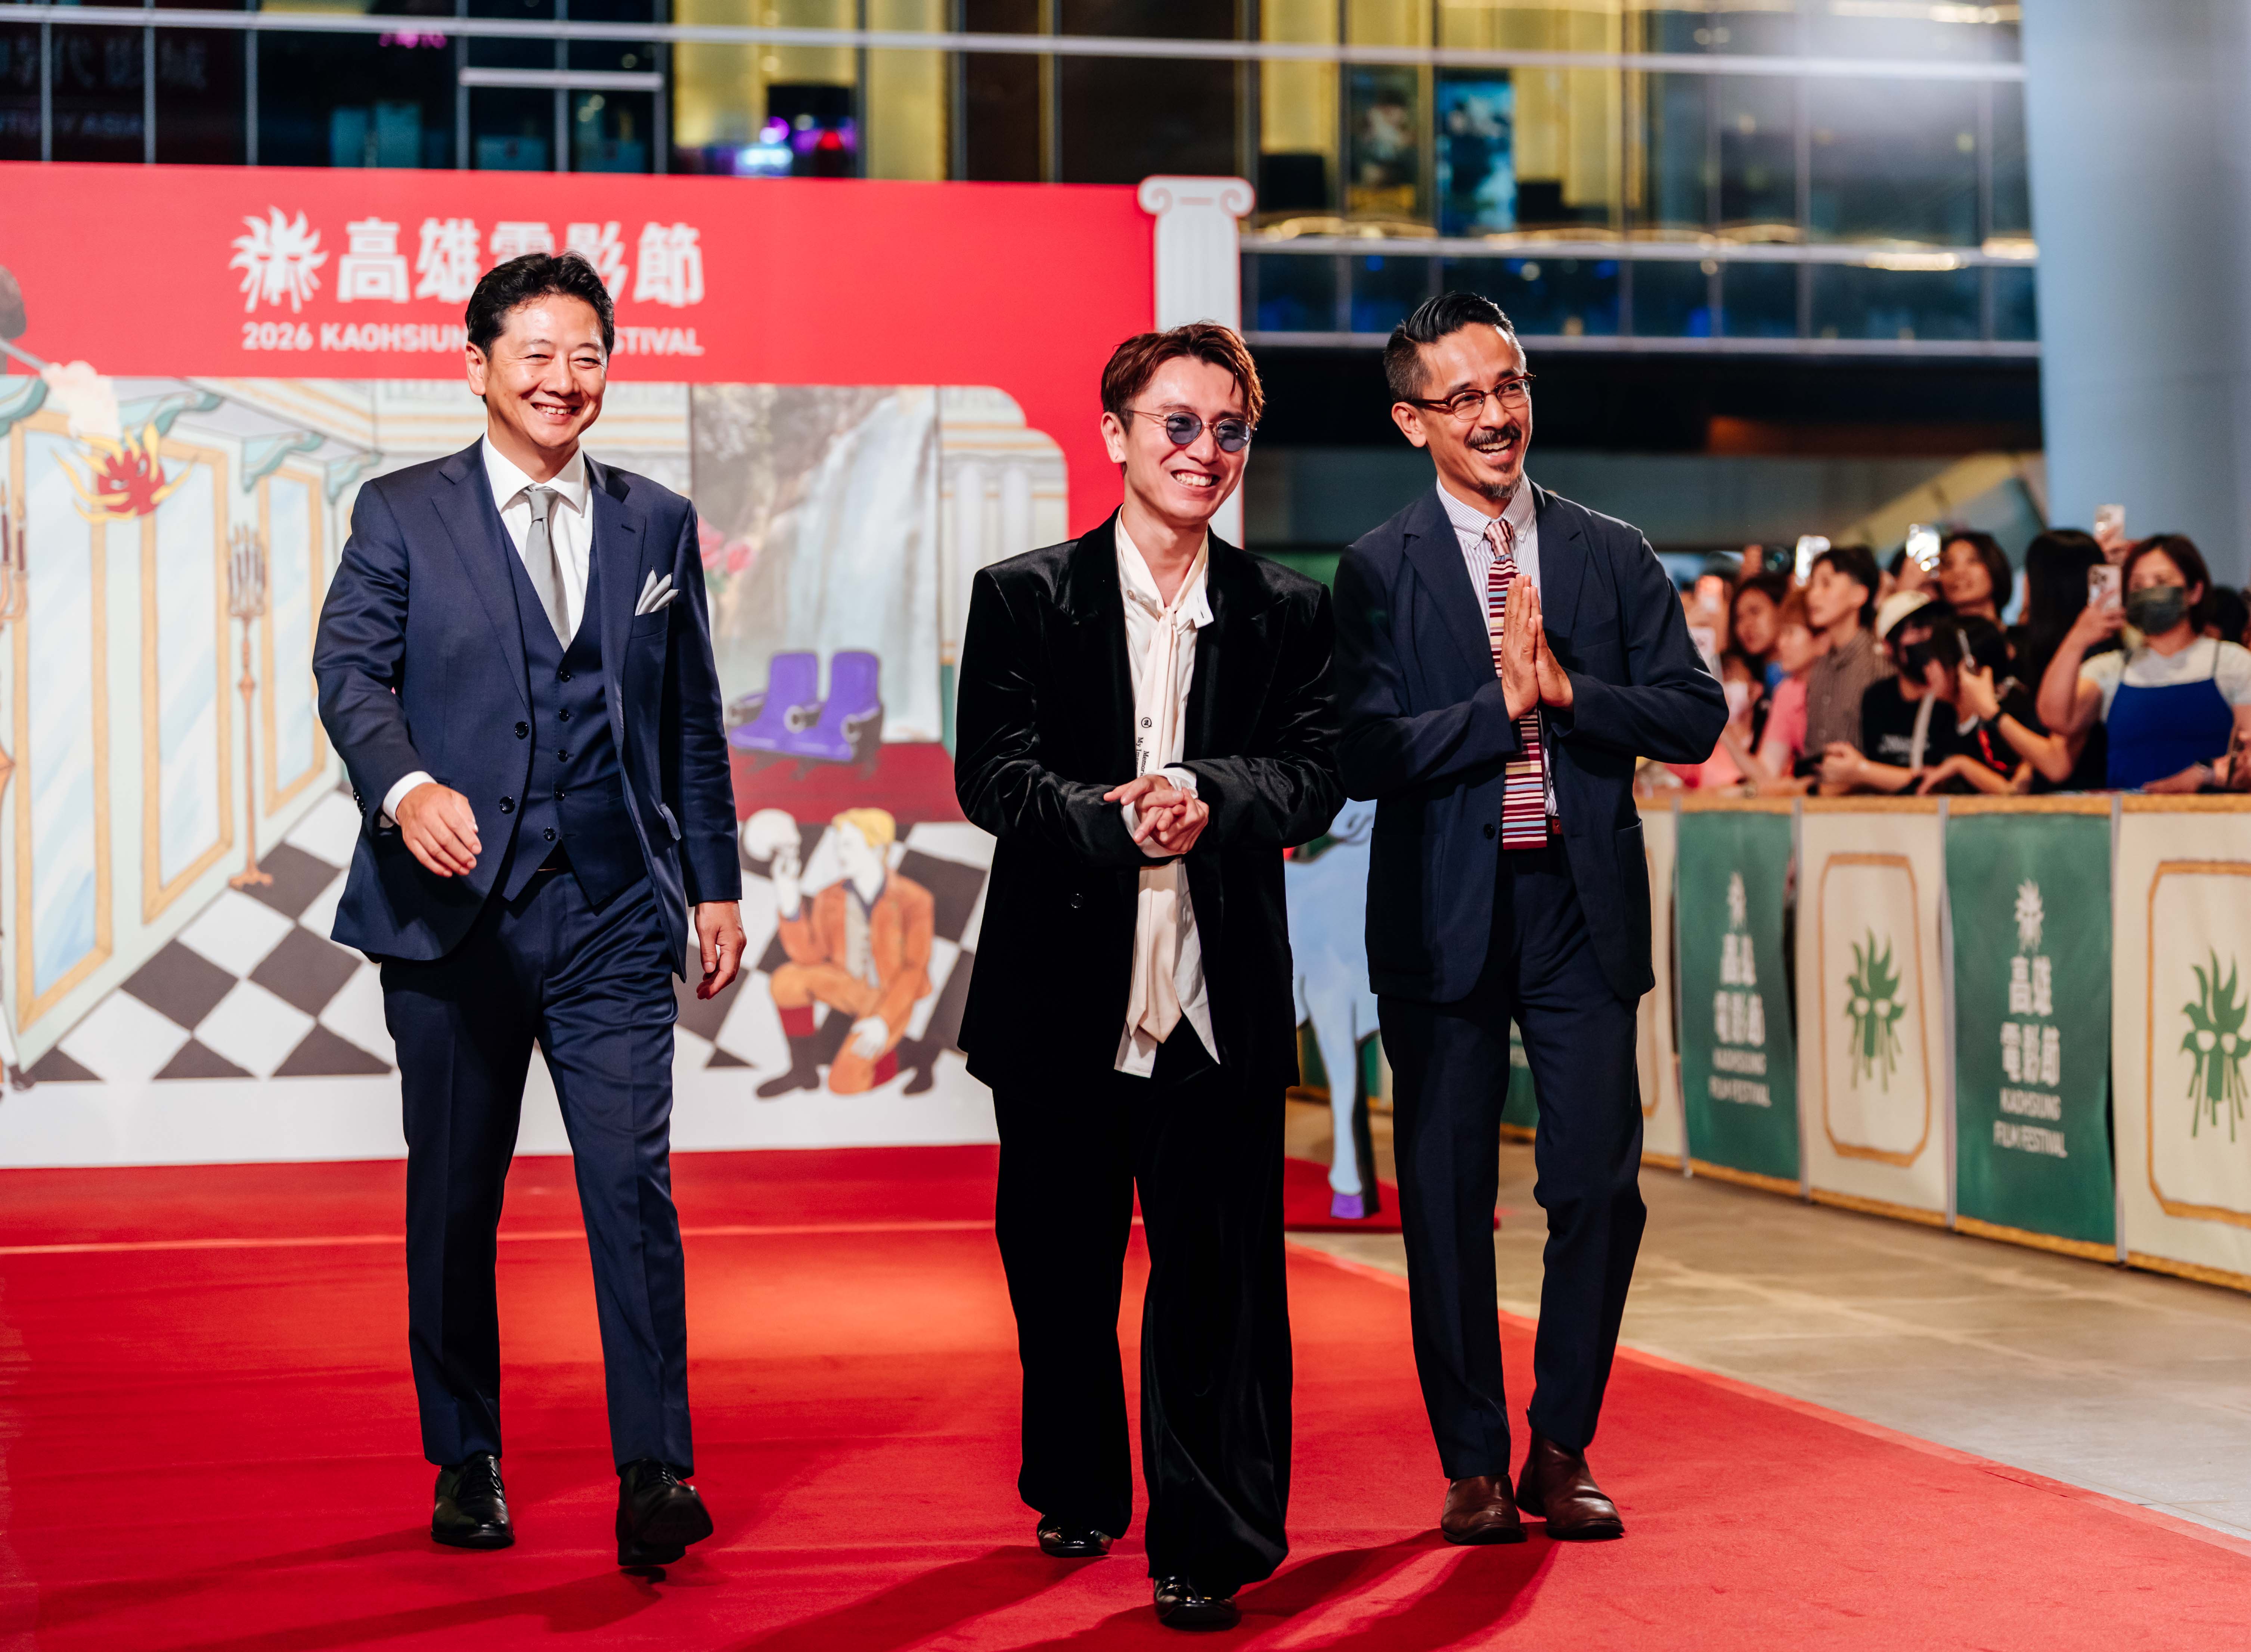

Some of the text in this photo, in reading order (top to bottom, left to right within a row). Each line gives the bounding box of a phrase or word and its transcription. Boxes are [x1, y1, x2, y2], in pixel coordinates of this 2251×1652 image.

[242, 321, 706, 356] 2026 KAOHSIUN STIVAL
[1136, 737, 1144, 747] My
[2009, 955, 2053, 1016] 高雄
[2000, 1022, 2061, 1087] 電影節
[1999, 1087, 2061, 1121] KAOHSIUNG
[2020, 1124, 2068, 1158] FESTIVAL
